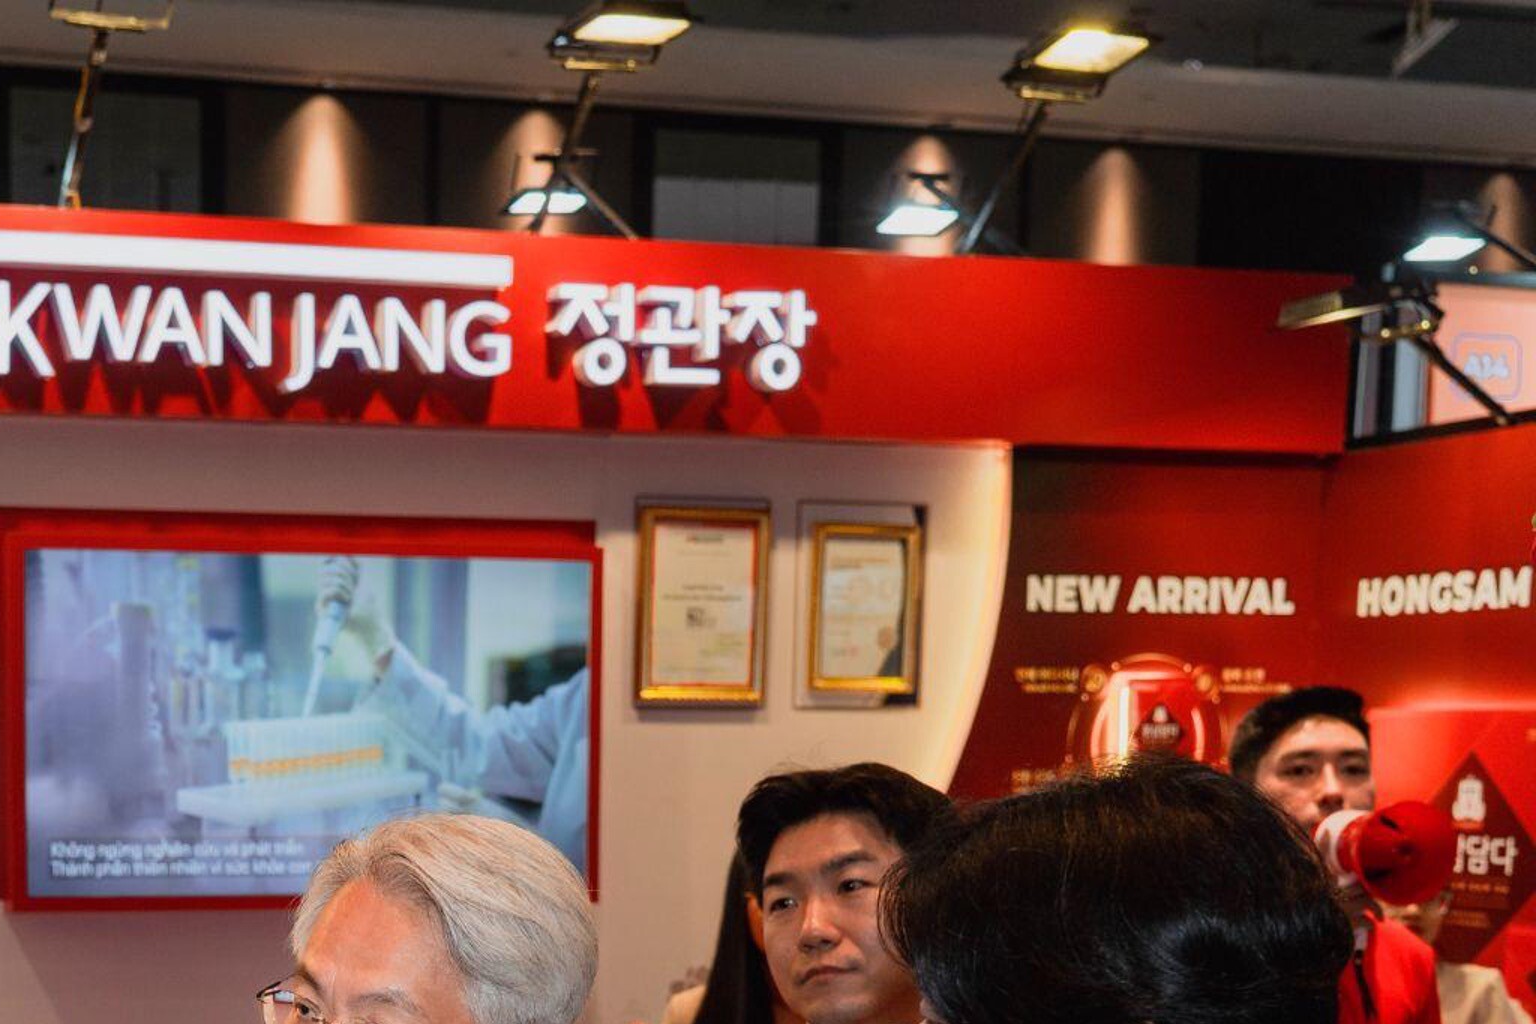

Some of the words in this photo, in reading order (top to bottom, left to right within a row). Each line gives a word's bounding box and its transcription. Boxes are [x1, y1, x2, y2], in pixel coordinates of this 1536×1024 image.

[278, 290, 514, 394] JANG
[545, 281, 818, 394] 정관장
[1024, 573, 1123, 614] NEW
[1126, 575, 1296, 617] ARRIVAL
[1355, 565, 1534, 618] HONGSAM
